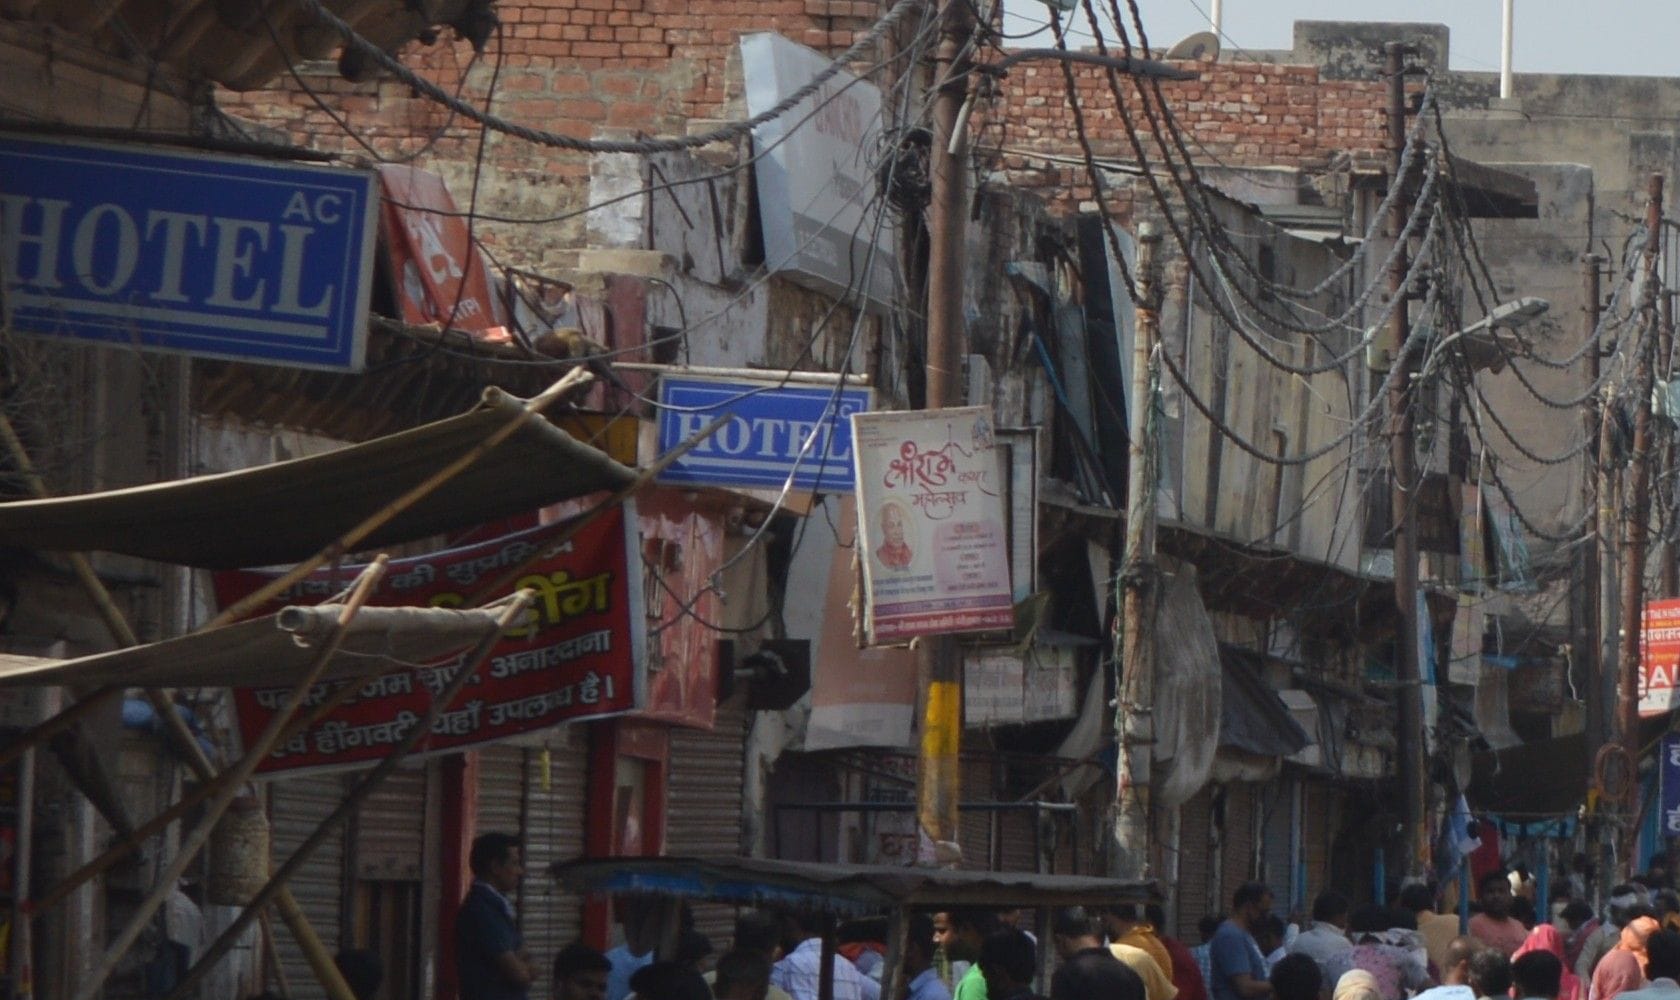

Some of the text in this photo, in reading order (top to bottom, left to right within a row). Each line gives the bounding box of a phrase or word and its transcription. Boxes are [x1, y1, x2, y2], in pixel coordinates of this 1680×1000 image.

[282, 191, 341, 224] AC
[4, 194, 333, 318] HOTEL
[827, 403, 853, 419] AC
[677, 413, 850, 461] HOTEL
[447, 539, 573, 586] सुप्रसि
[492, 630, 612, 679] अनारदाना
[430, 701, 481, 735] यहाँ
